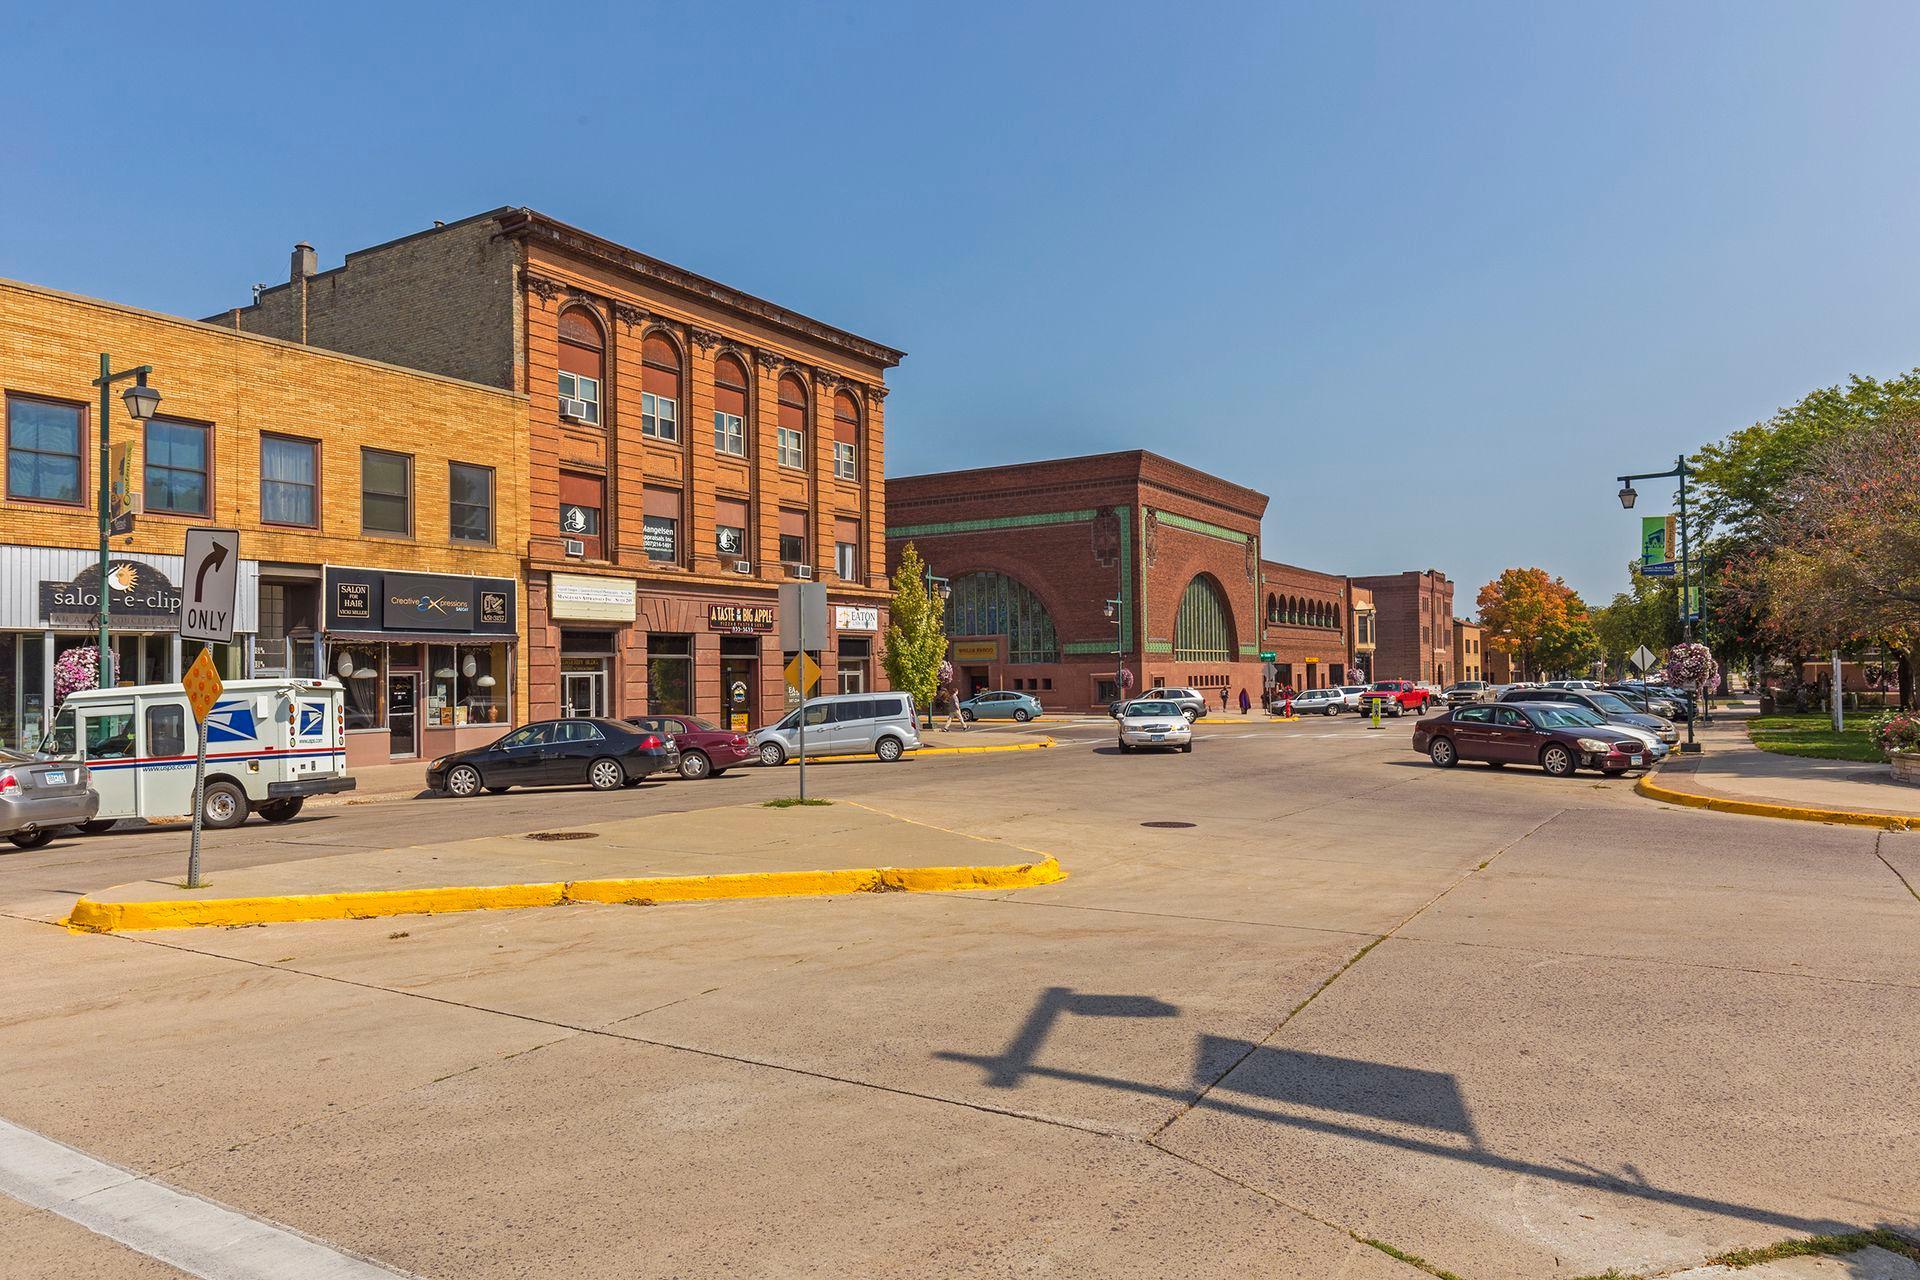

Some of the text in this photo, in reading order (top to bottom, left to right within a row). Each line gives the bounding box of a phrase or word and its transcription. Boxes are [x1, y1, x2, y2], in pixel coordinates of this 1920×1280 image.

[341, 585, 366, 594] SALON
[54, 587, 181, 614] salo-e-clip
[344, 599, 363, 608] HAIR
[390, 596, 420, 605] Creative
[188, 608, 227, 631] ONLY
[711, 606, 717, 621] A
[717, 606, 735, 621] TASTE
[742, 608, 753, 622] BIG
[754, 609, 773, 623] APPLE
[851, 611, 876, 621] EATON
[143, 763, 192, 773] www.usps.com
